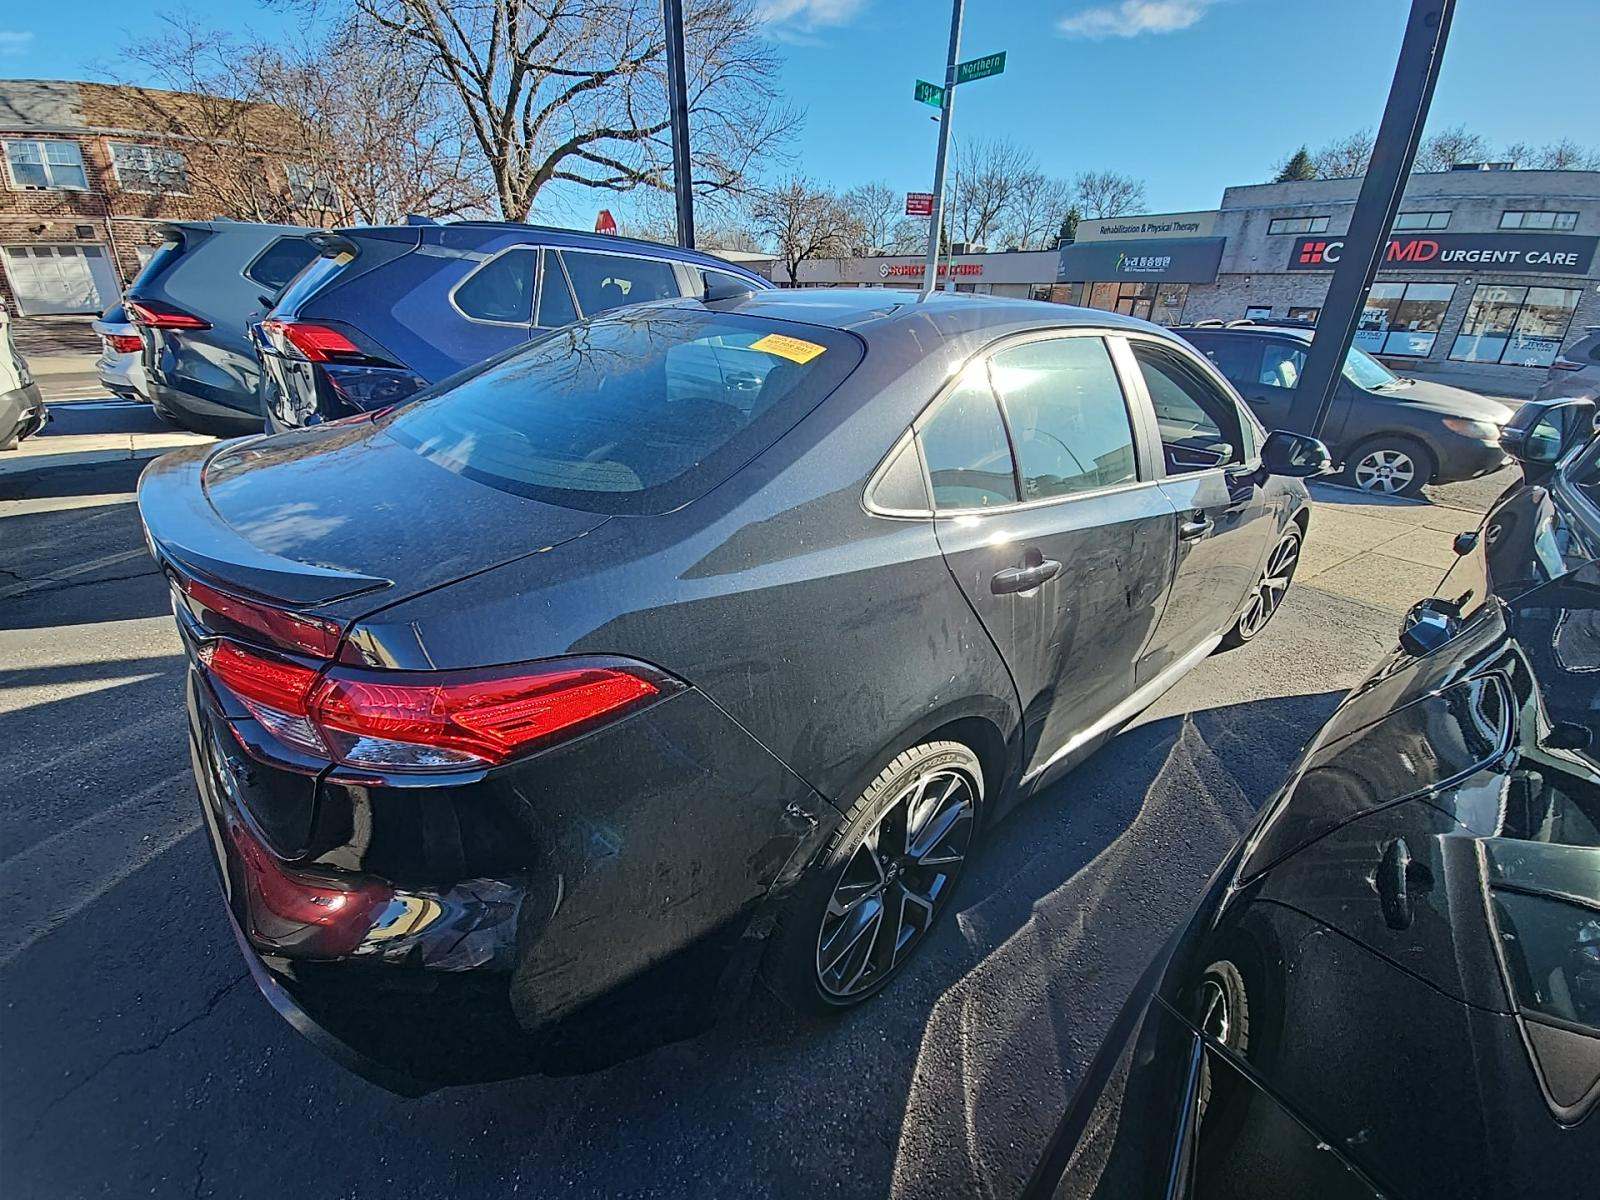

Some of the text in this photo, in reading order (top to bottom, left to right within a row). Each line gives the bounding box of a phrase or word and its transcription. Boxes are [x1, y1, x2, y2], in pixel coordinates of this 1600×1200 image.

[962, 57, 1000, 75] Northern
[1100, 222, 1200, 235] Rehabilitation & Physical Therapy
[1441, 249, 1520, 264] URGENT
[1525, 251, 1579, 267] CARE
